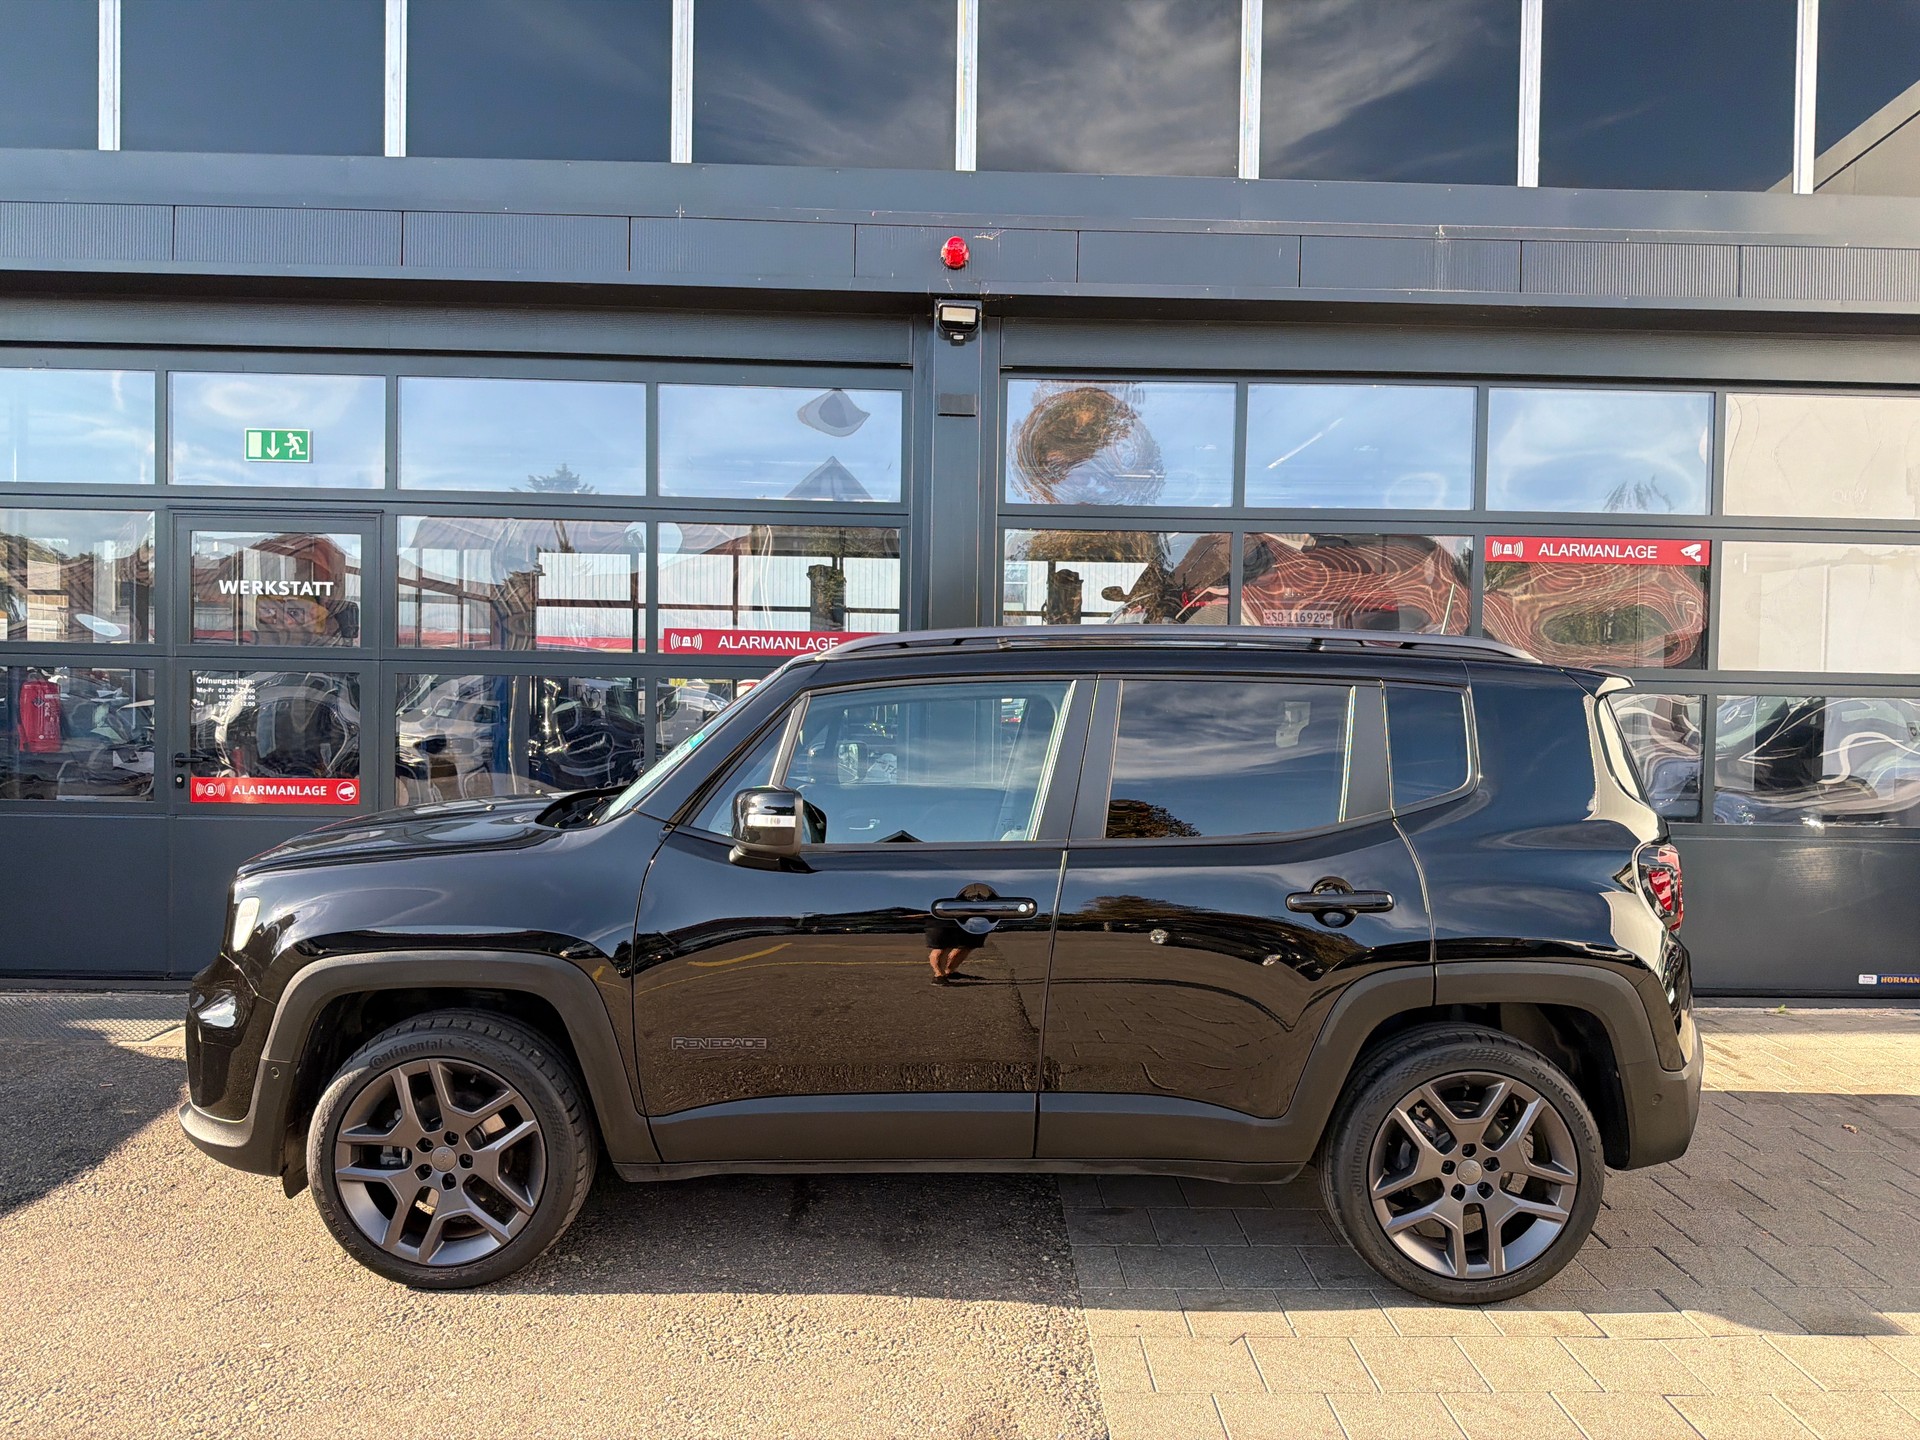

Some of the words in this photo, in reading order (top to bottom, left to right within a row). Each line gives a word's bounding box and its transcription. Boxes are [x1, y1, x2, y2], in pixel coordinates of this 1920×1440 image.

[1538, 542, 1658, 559] ALARMANLAGE
[218, 579, 334, 596] WERKSTATT
[718, 635, 839, 651] ALARMANLAGE
[232, 784, 327, 797] ALARMANLAGE
[671, 1036, 767, 1050] RENEGADE
[369, 1038, 443, 1070] Continental
[1530, 1066, 1593, 1143] SportContact
